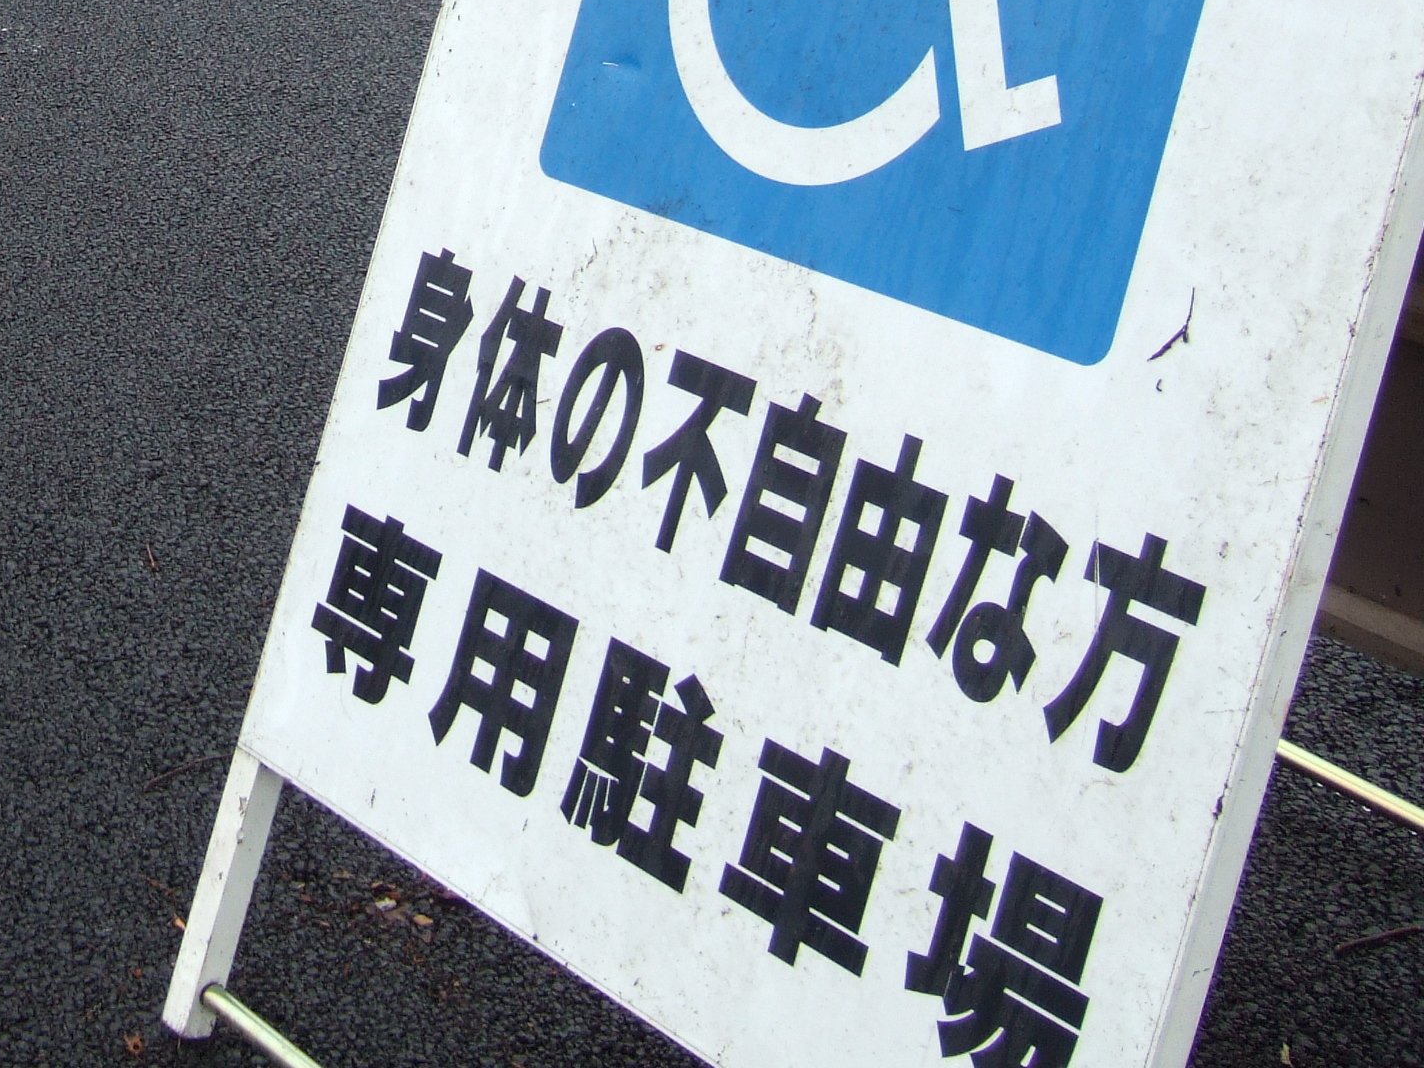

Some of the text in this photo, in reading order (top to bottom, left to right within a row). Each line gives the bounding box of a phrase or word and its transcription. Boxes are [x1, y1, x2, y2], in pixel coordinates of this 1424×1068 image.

[377, 248, 1206, 773] 身体の不自由な方
[310, 504, 1104, 1068] 専用駐車場
